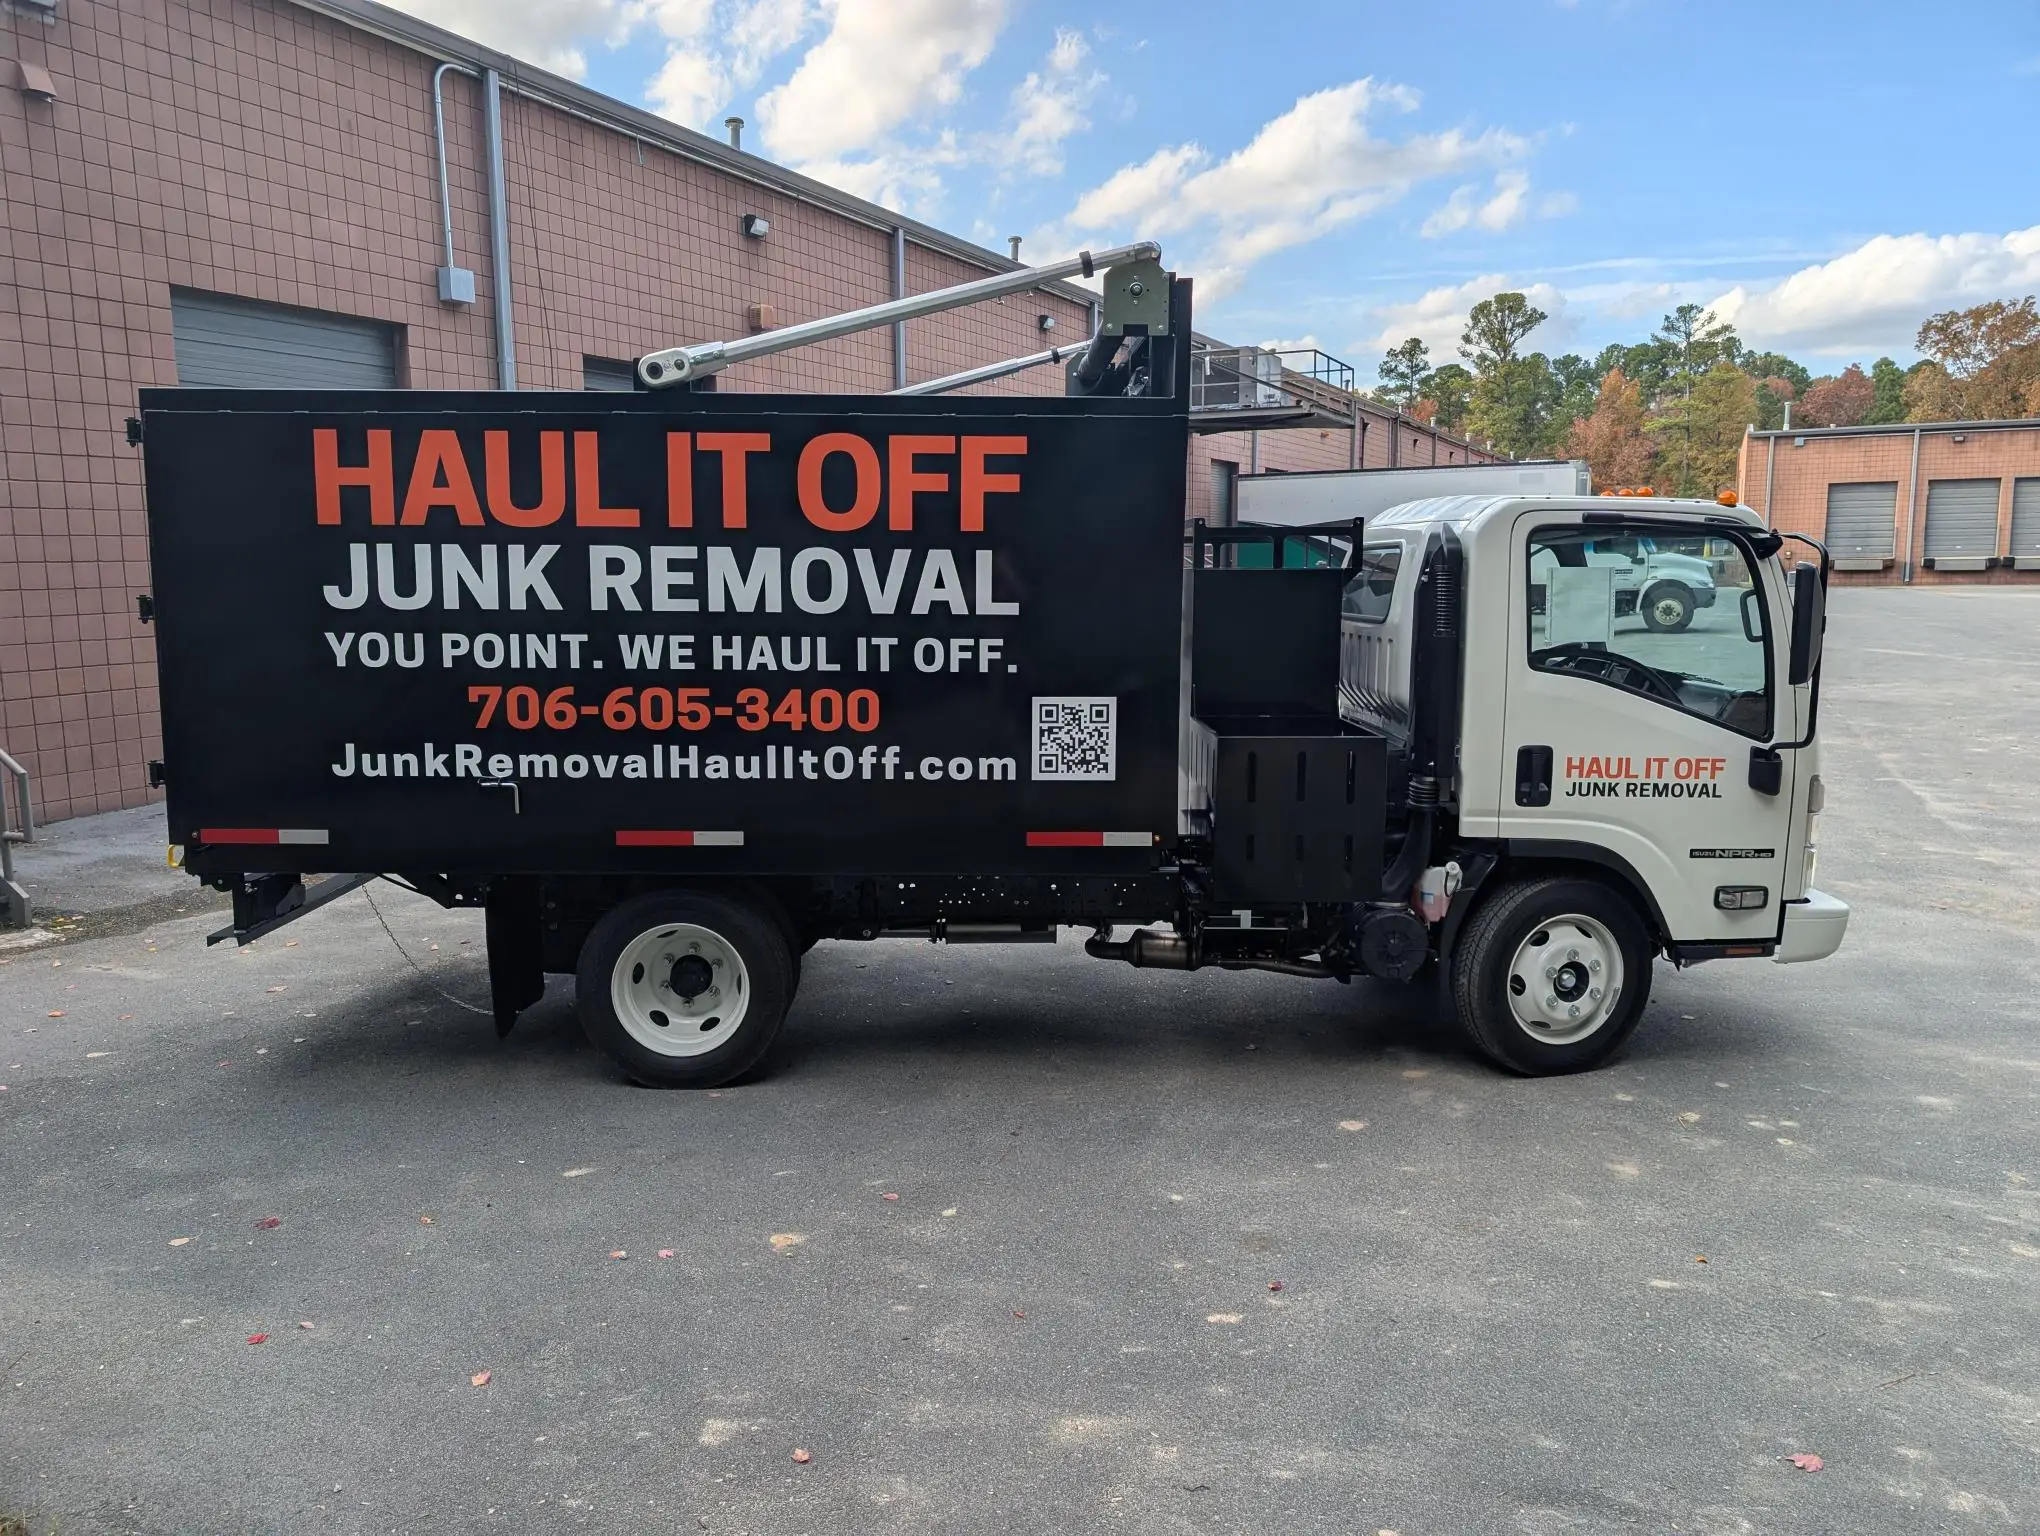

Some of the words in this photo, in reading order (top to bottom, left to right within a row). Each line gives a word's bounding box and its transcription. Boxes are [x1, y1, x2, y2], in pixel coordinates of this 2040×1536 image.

[313, 428, 641, 528] HAUL
[667, 431, 771, 529] IT
[797, 432, 1028, 532] OFF
[323, 543, 564, 611] JUNK
[589, 544, 1020, 616] REMOVAL
[324, 631, 425, 669] YOU
[441, 632, 604, 669] POINT.
[617, 634, 696, 670] WE
[712, 635, 841, 672] HAUL
[856, 636, 899, 672] IT
[913, 637, 1018, 674] OFF.
[467, 685, 880, 732] 706-605-3400
[331, 742, 1017, 781] JunkRemovalHaulItOff.com
[1565, 756, 1639, 779] HAUL
[1644, 757, 1670, 780] IT
[1673, 757, 1727, 780] OFF
[1565, 781, 1620, 797] JUNK
[1625, 782, 1722, 798] REMOVAL
